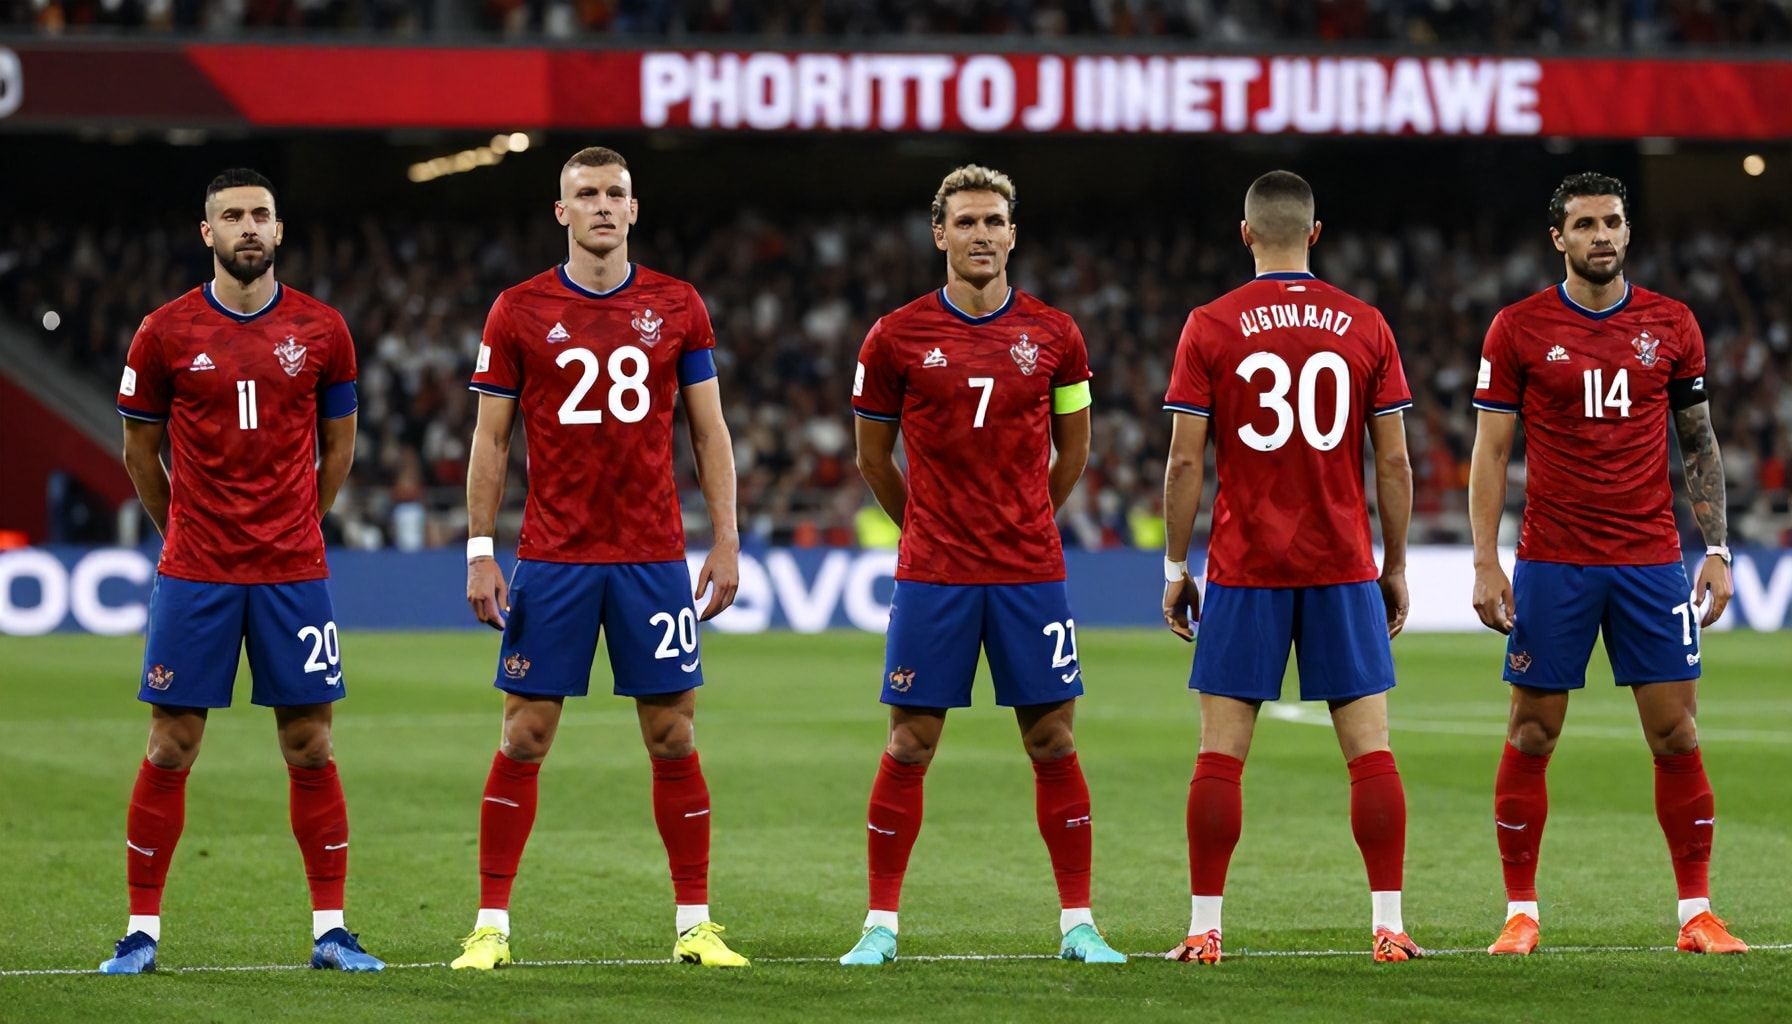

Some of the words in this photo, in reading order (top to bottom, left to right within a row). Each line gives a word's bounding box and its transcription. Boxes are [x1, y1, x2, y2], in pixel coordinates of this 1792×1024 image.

[236, 379, 258, 430] 11
[555, 345, 651, 425] 28
[968, 377, 994, 428] 7
[1235, 351, 1350, 451] 30
[1583, 368, 1632, 418] 114
[297, 621, 339, 673] 20
[649, 607, 697, 660] 20
